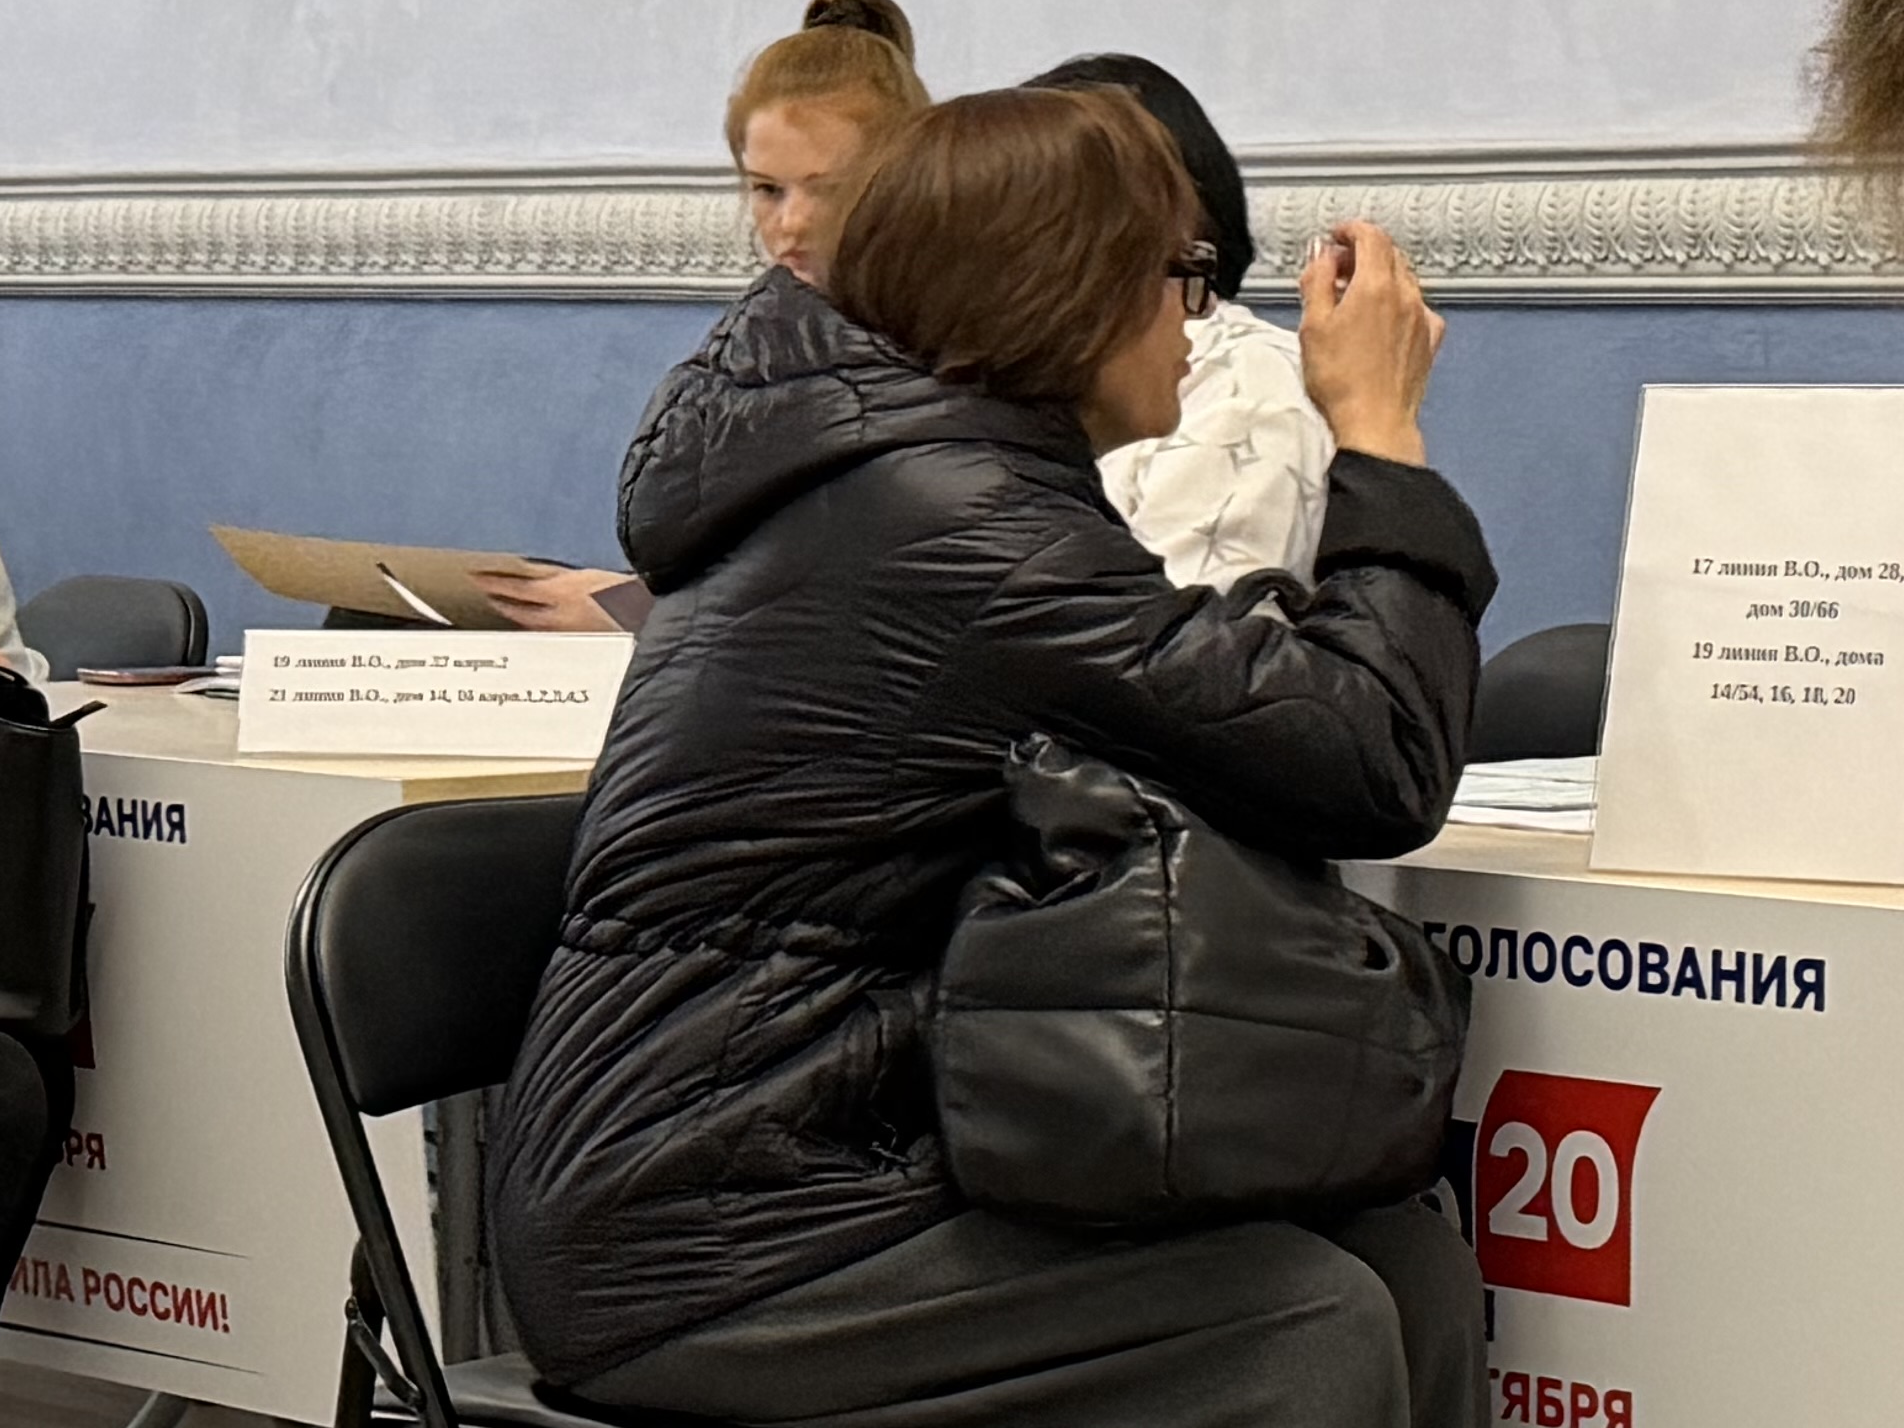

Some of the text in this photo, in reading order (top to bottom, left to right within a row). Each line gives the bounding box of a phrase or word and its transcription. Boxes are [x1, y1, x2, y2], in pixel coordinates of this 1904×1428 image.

[1693, 558, 1714, 575] 17
[1717, 562, 1778, 577] линия
[1784, 560, 1830, 581] В.О.,
[1834, 565, 1872, 582] дом
[1746, 600, 1840, 620] дом 30/66
[1693, 642, 1884, 666] 19 линия В.О., дома
[1771, 685, 1795, 704] 16,
[1834, 687, 1856, 705] 20
[1489, 1121, 1619, 1250] 20
[9, 1256, 75, 1303] ИЛА
[82, 1266, 230, 1333] РОССИИ!
